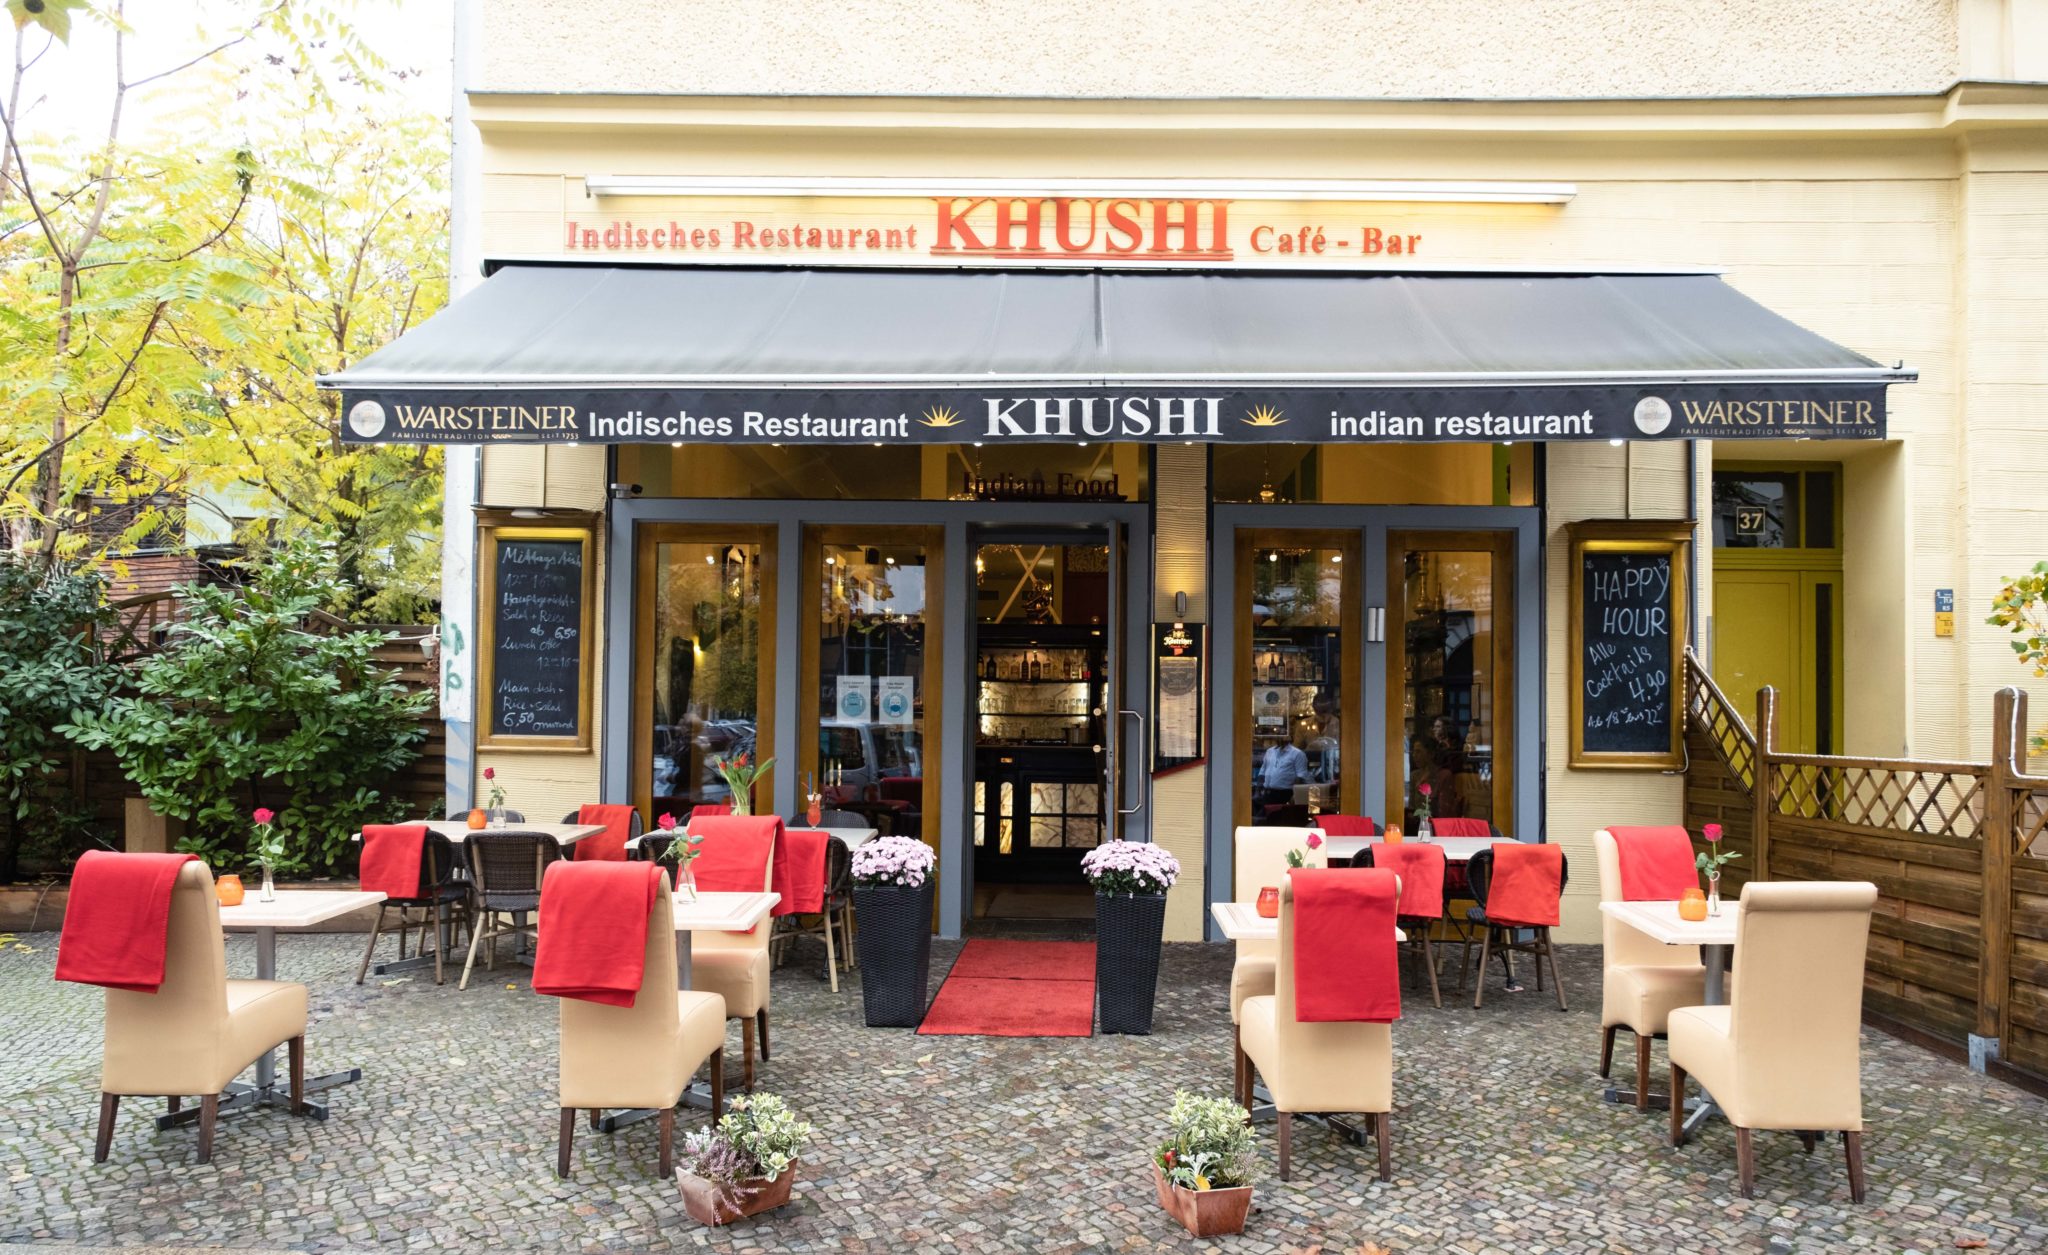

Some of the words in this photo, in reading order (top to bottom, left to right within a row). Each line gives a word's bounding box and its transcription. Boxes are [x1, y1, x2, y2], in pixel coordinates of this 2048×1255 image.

[566, 221, 720, 249] Indisches
[732, 221, 917, 250] Restaurant
[930, 196, 1234, 253] KHUSHI
[1250, 225, 1326, 255] Café
[1361, 226, 1421, 255] Bar
[393, 405, 579, 430] WARSTEINER
[589, 410, 733, 437] Indisches
[743, 411, 909, 438] Restaurant
[982, 397, 1224, 437] KHUSHI
[1331, 411, 1424, 436] indian
[1435, 409, 1594, 436] restaurant
[1680, 400, 1876, 425] WARSTEINER
[964, 472, 1046, 495] Indian
[1057, 473, 1119, 496] Food
[1739, 513, 1762, 529] 37
[1594, 565, 1670, 603] HAPPY
[1603, 607, 1668, 637] HOUR
[1589, 642, 1616, 665] Alle
[1587, 646, 1652, 697] Cocktails
[498, 678, 530, 693] Main
